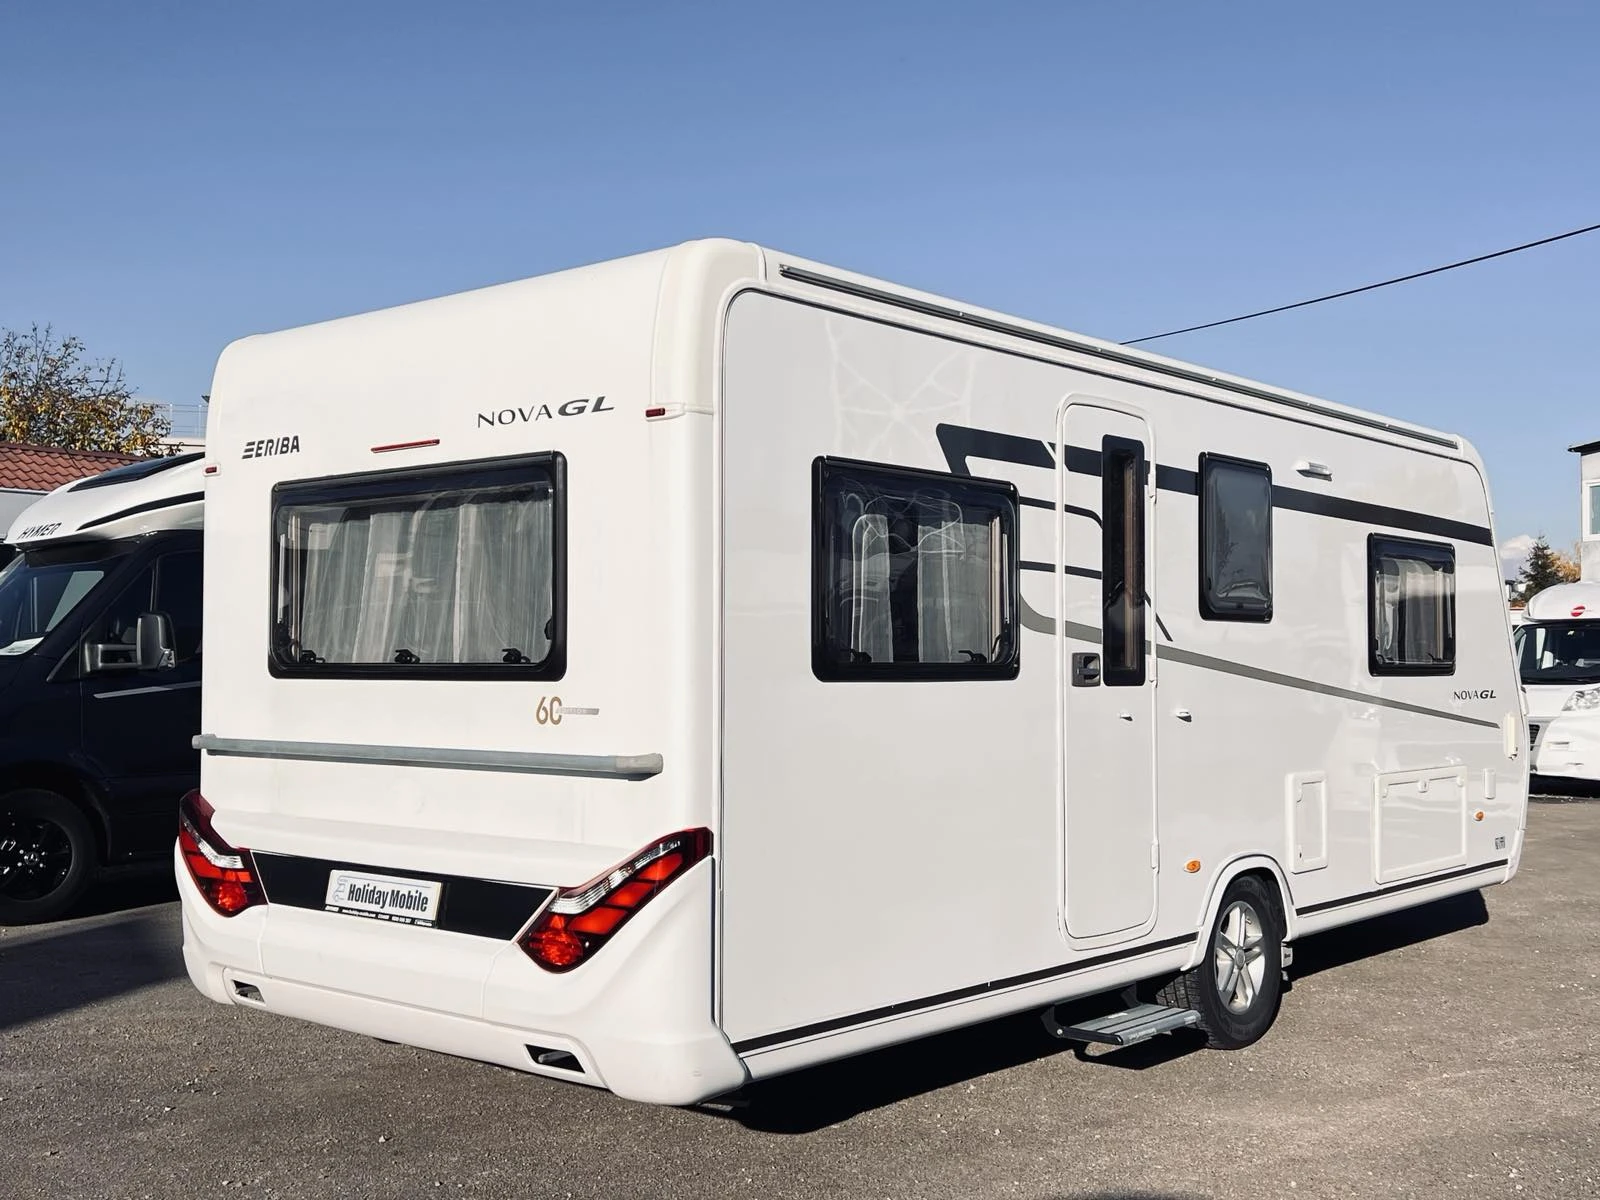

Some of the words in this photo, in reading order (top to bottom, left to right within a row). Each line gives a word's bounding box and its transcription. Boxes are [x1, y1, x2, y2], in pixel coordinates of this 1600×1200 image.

[242, 435, 300, 459] ERIBA
[16, 522, 62, 540] HYMER
[347, 883, 389, 909] Holiday
[389, 889, 429, 912] Mobile
